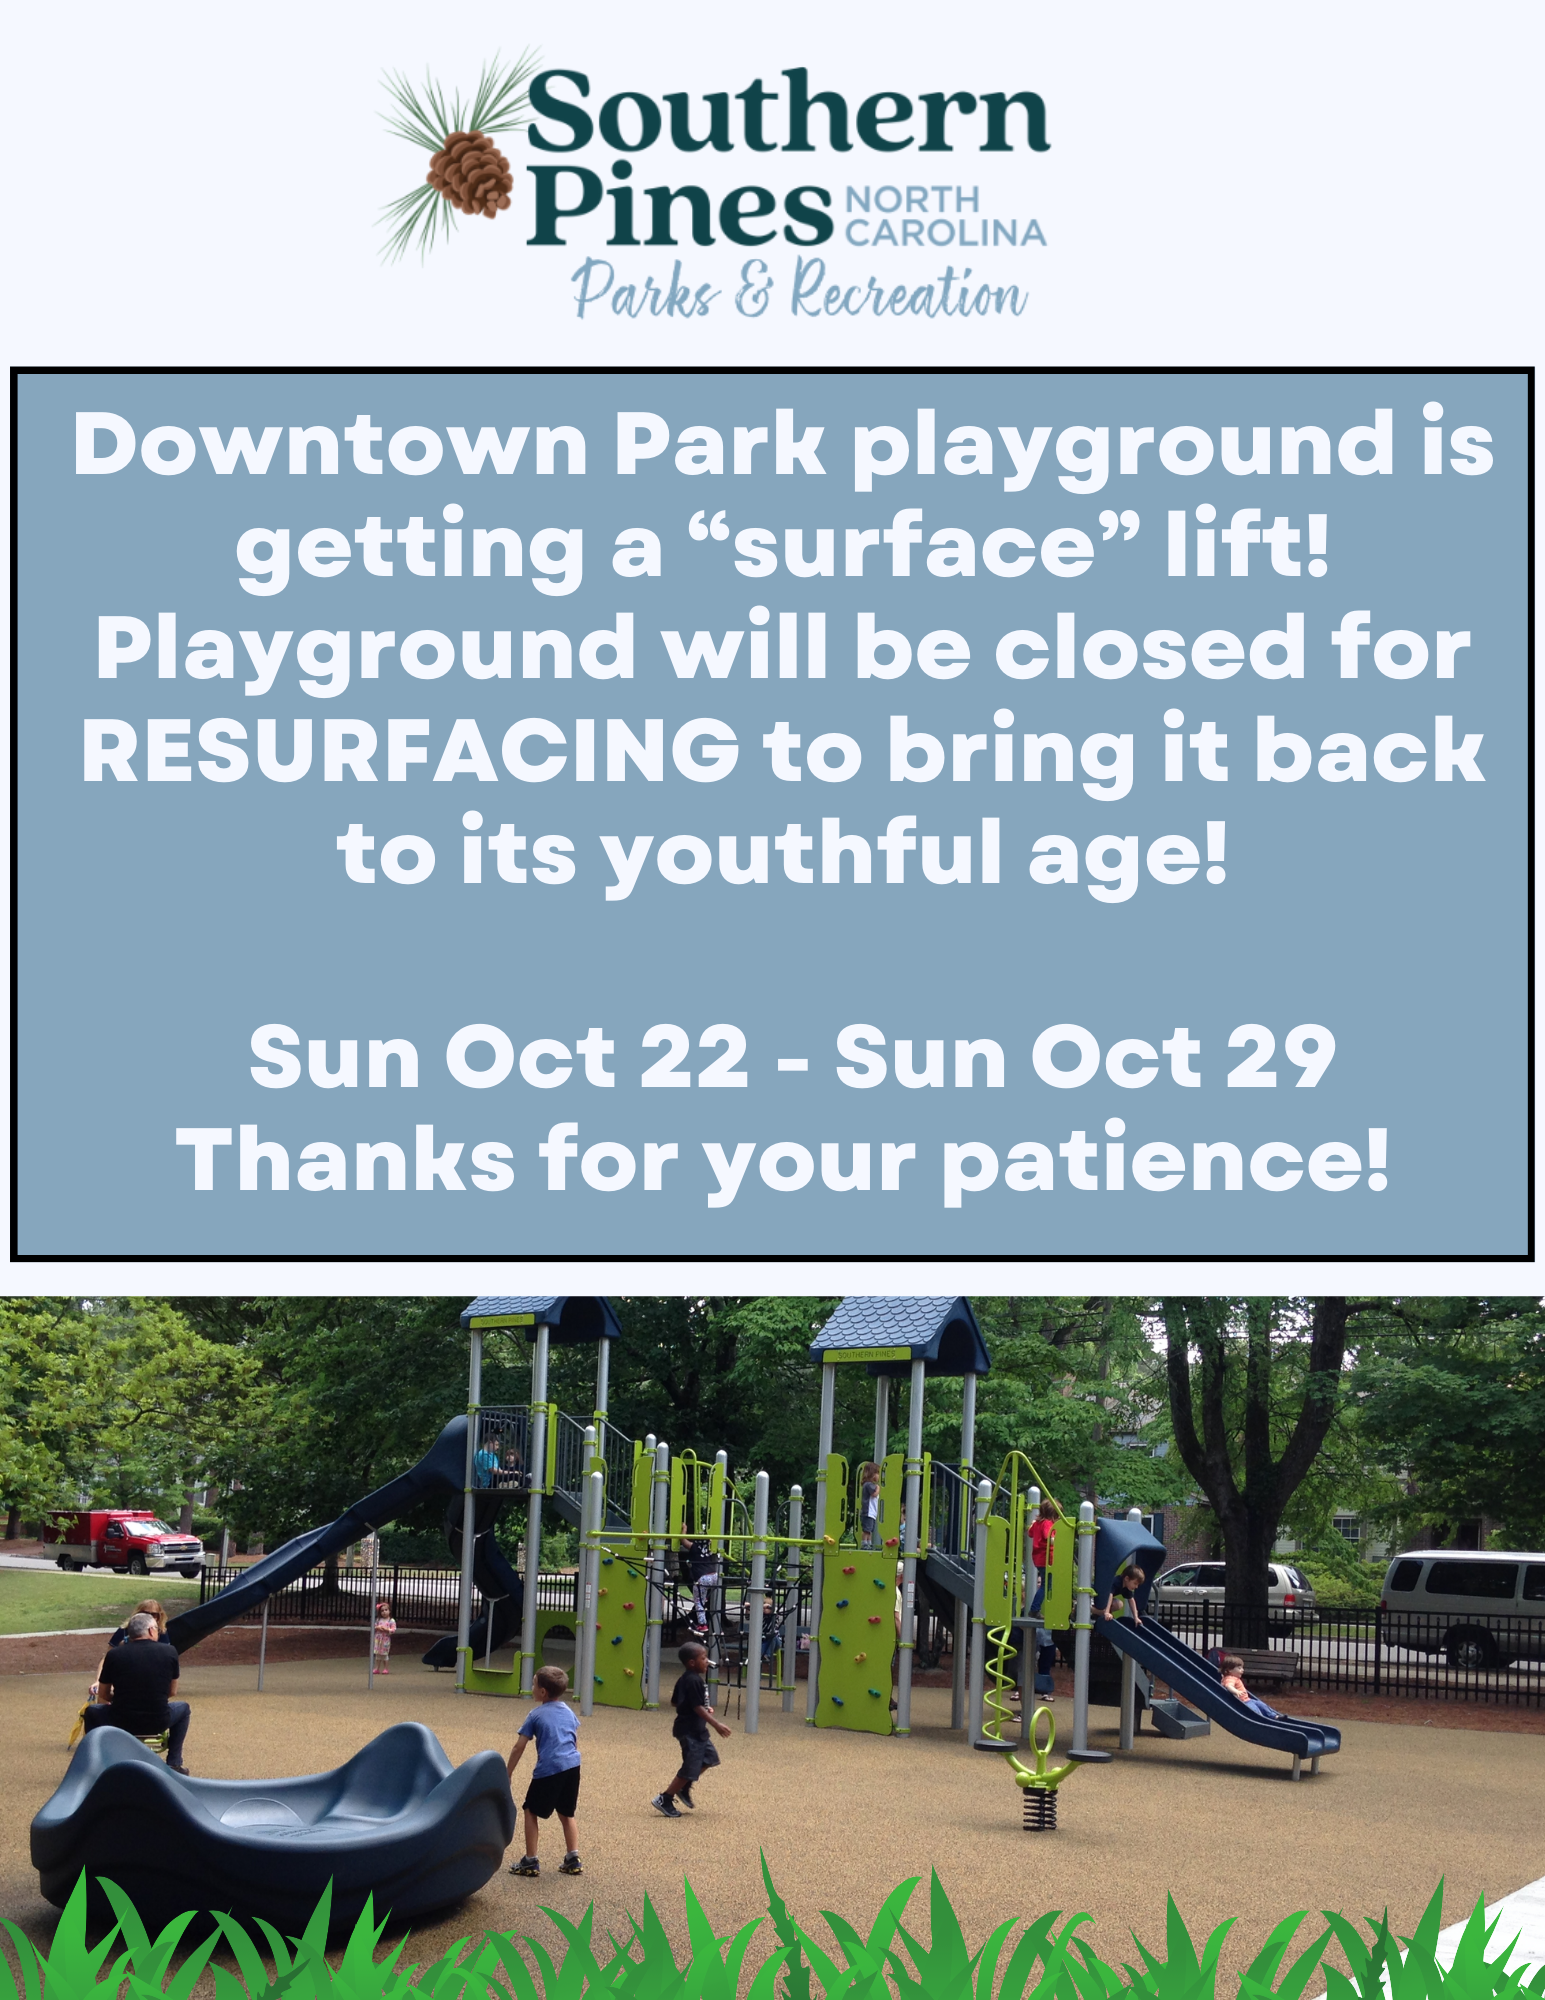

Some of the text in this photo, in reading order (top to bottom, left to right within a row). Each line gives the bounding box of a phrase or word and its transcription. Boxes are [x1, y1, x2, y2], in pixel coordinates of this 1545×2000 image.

[527, 66, 1051, 154] Southern
[526, 159, 835, 247] Pines
[845, 218, 1048, 247] CAROLINA
[846, 185, 979, 214] NORTH
[571, 255, 1029, 319] Parks & Recreation
[76, 402, 1493, 494] Downtown Park playground is
[237, 504, 582, 596] getting
[613, 528, 661, 577] a
[1168, 504, 1327, 577] lift!
[99, 606, 1470, 698] Playground will be closed for
[84, 709, 1486, 801] RESURFACING to bring it back
[337, 811, 1225, 903] to its youthful age!
[251, 1024, 418, 1088] Sun
[447, 1024, 614, 1088] Oct
[642, 1024, 747, 1087] 22
[837, 1024, 1004, 1088] Sun
[1033, 1024, 1200, 1088] Oct
[1228, 1024, 1335, 1087] 29
[176, 1118, 1387, 1208] Thanks for your patience!
[838, 1351, 874, 1359] SOUTHERN
